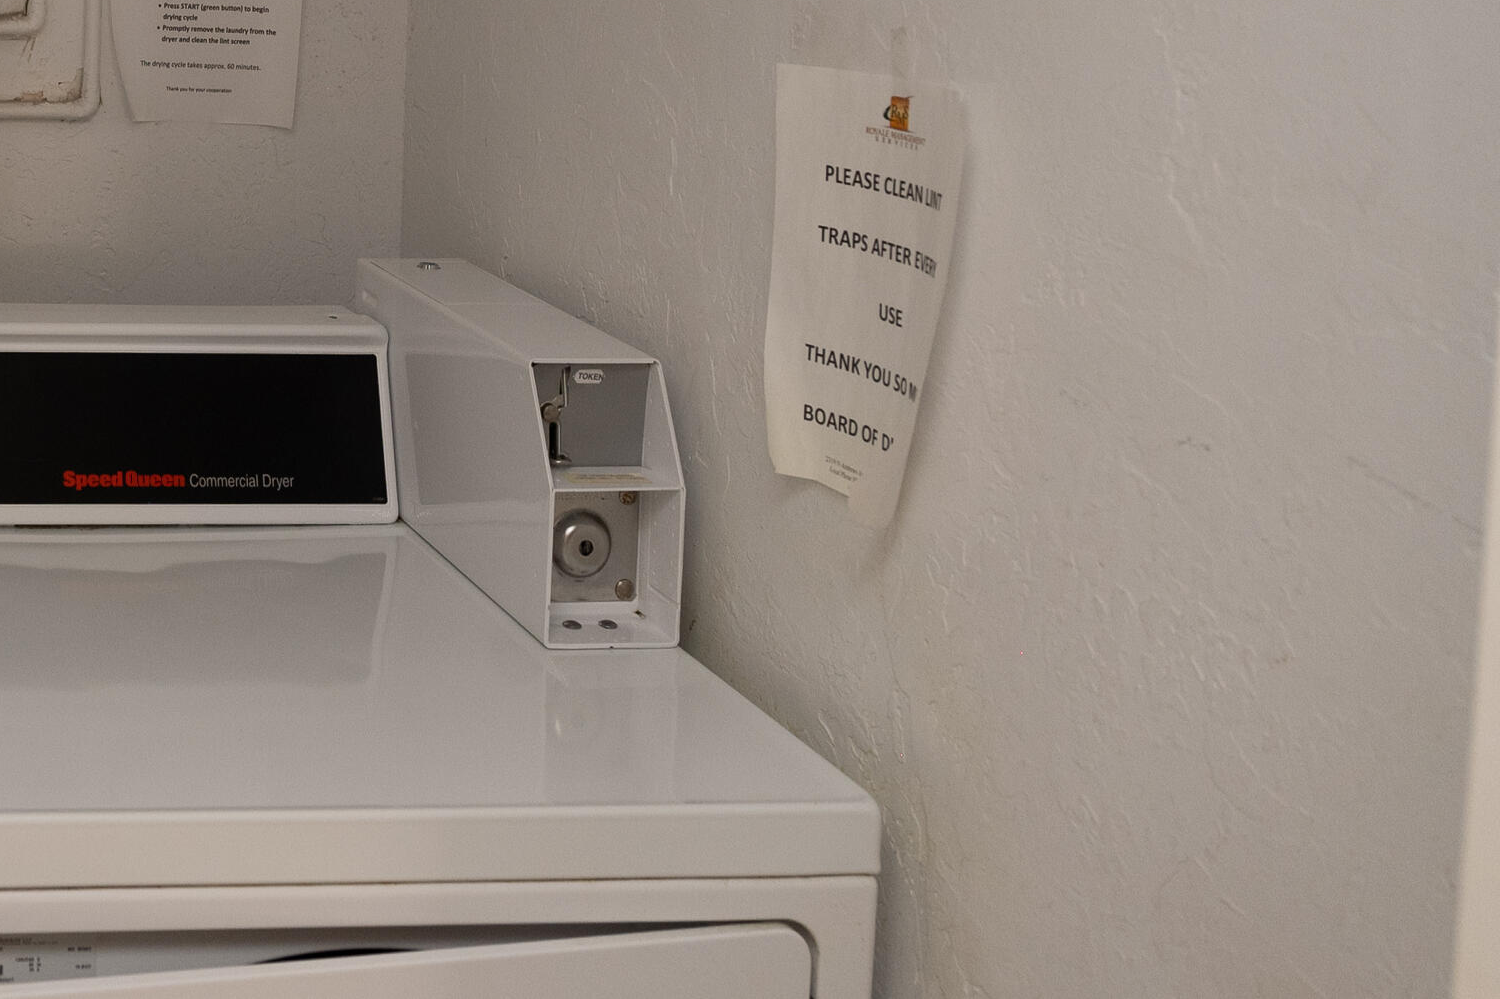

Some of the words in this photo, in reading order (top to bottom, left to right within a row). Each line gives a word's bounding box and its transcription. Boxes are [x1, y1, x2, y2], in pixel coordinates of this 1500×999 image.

[162, 13, 182, 21] drying
[200, 4, 220, 12] (green
[251, 5, 269, 14] begin
[162, 24, 190, 33] Promptly
[151, 60, 170, 69] drying
[825, 164, 880, 192] PLEASE
[884, 176, 923, 204] CLEAN
[925, 188, 942, 211] LINT
[818, 224, 868, 252] TRAPS
[871, 238, 912, 266] AFTER
[879, 303, 904, 328] USE
[578, 372, 604, 381] TOKEN
[805, 343, 860, 375] THANK
[864, 360, 891, 387] YOU
[893, 374, 907, 395] SO
[803, 404, 858, 437] BOARD
[862, 424, 878, 446] OF
[63, 470, 123, 490] Speed
[125, 470, 186, 488] Queen
[189, 473, 259, 488] Commercial
[262, 474, 294, 491] Dryer
